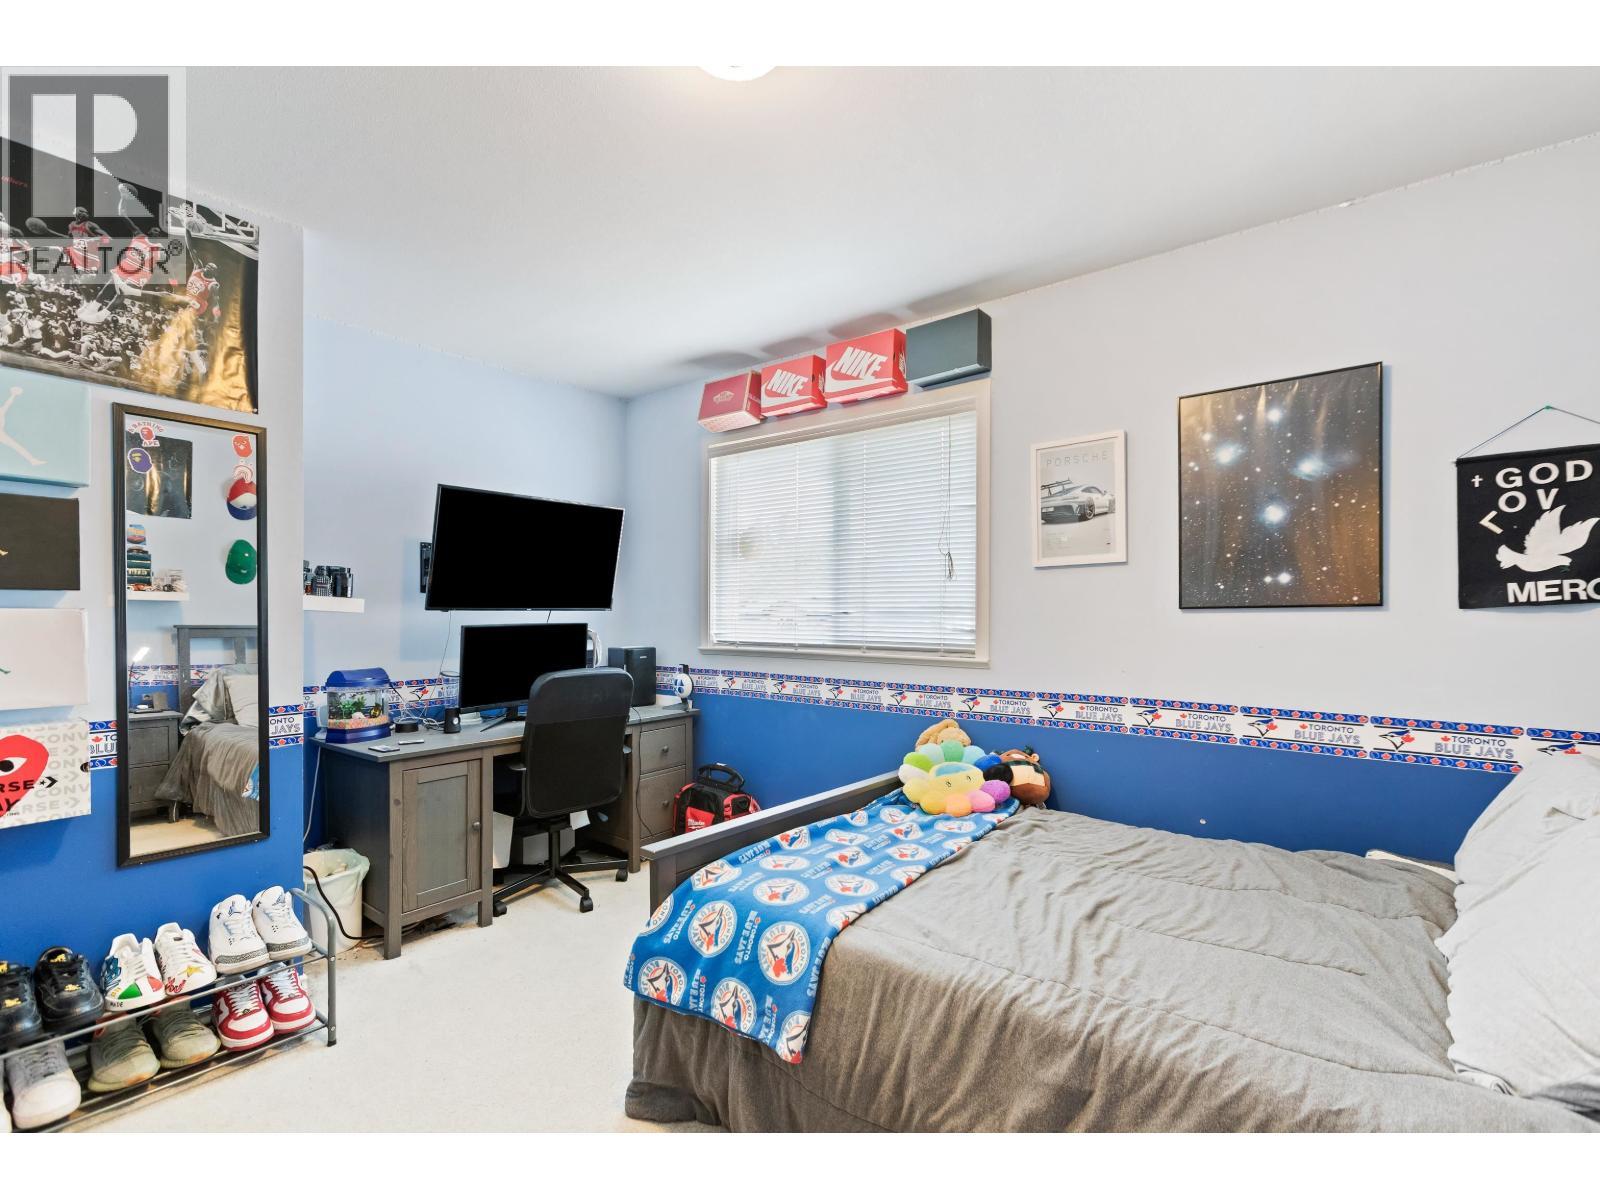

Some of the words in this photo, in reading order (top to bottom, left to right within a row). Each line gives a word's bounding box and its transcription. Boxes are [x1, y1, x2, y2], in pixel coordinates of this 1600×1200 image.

[833, 346, 888, 379] NIKE
[766, 368, 808, 398] NIKE
[1047, 450, 1109, 467] PORSCHE
[1496, 460, 1593, 488] GOD
[916, 698, 931, 706] BLUE
[933, 700, 951, 708] JAYS
[990, 705, 1009, 713] BLUE
[1010, 706, 1030, 715] JAYS
[270, 716, 294, 725] ONTO
[1075, 711, 1097, 720] BLUE
[1099, 713, 1123, 722] JAYS
[1188, 713, 1226, 722] TORONTO
[271, 723, 300, 735] JAYS
[1176, 719, 1203, 730] BLUE
[1205, 721, 1231, 732] JAYS
[1308, 724, 1354, 734] TORONTO
[1294, 730, 1326, 742] BLUE
[1328, 733, 1360, 745] JAYS
[1450, 735, 1506, 747] TORONTO
[1435, 742, 1473, 756] BLUE
[1475, 746, 1514, 760] JAYS
[743, 923, 758, 961] TORONTO
[735, 936, 750, 964] JAYS
[793, 931, 806, 973] TORONTO
